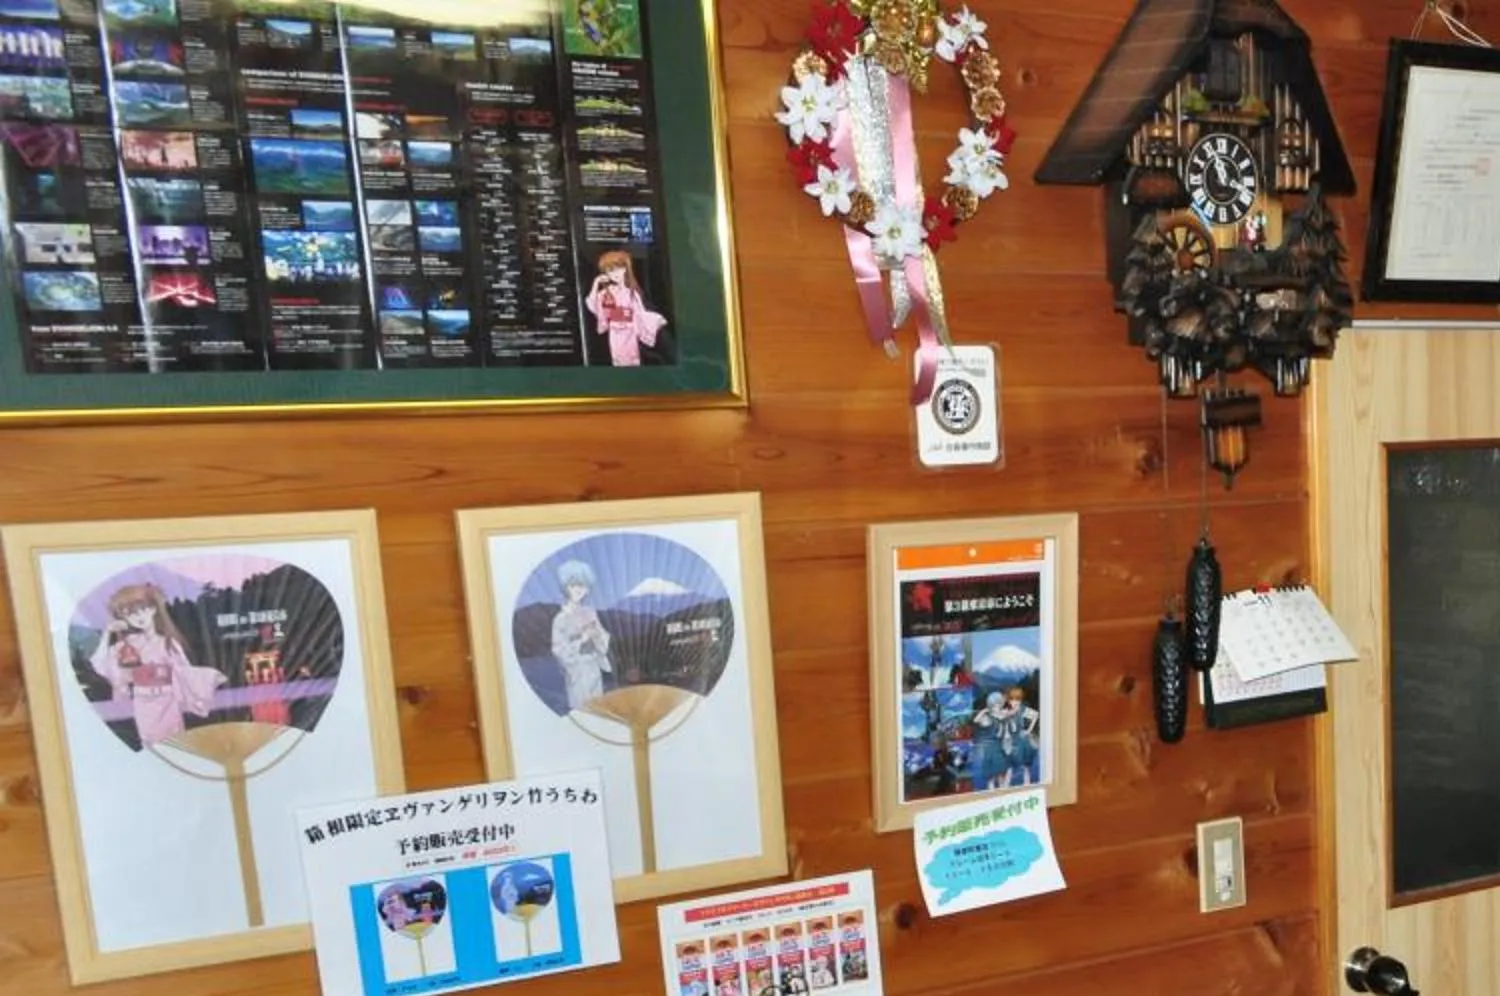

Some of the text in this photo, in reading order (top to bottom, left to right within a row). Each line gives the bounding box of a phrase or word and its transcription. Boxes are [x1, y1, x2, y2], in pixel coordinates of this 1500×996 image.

[304, 785, 599, 845] 箱根限定ヱヴァンゲリヲン竹うちわ
[397, 822, 516, 856] 予約販売受付中
